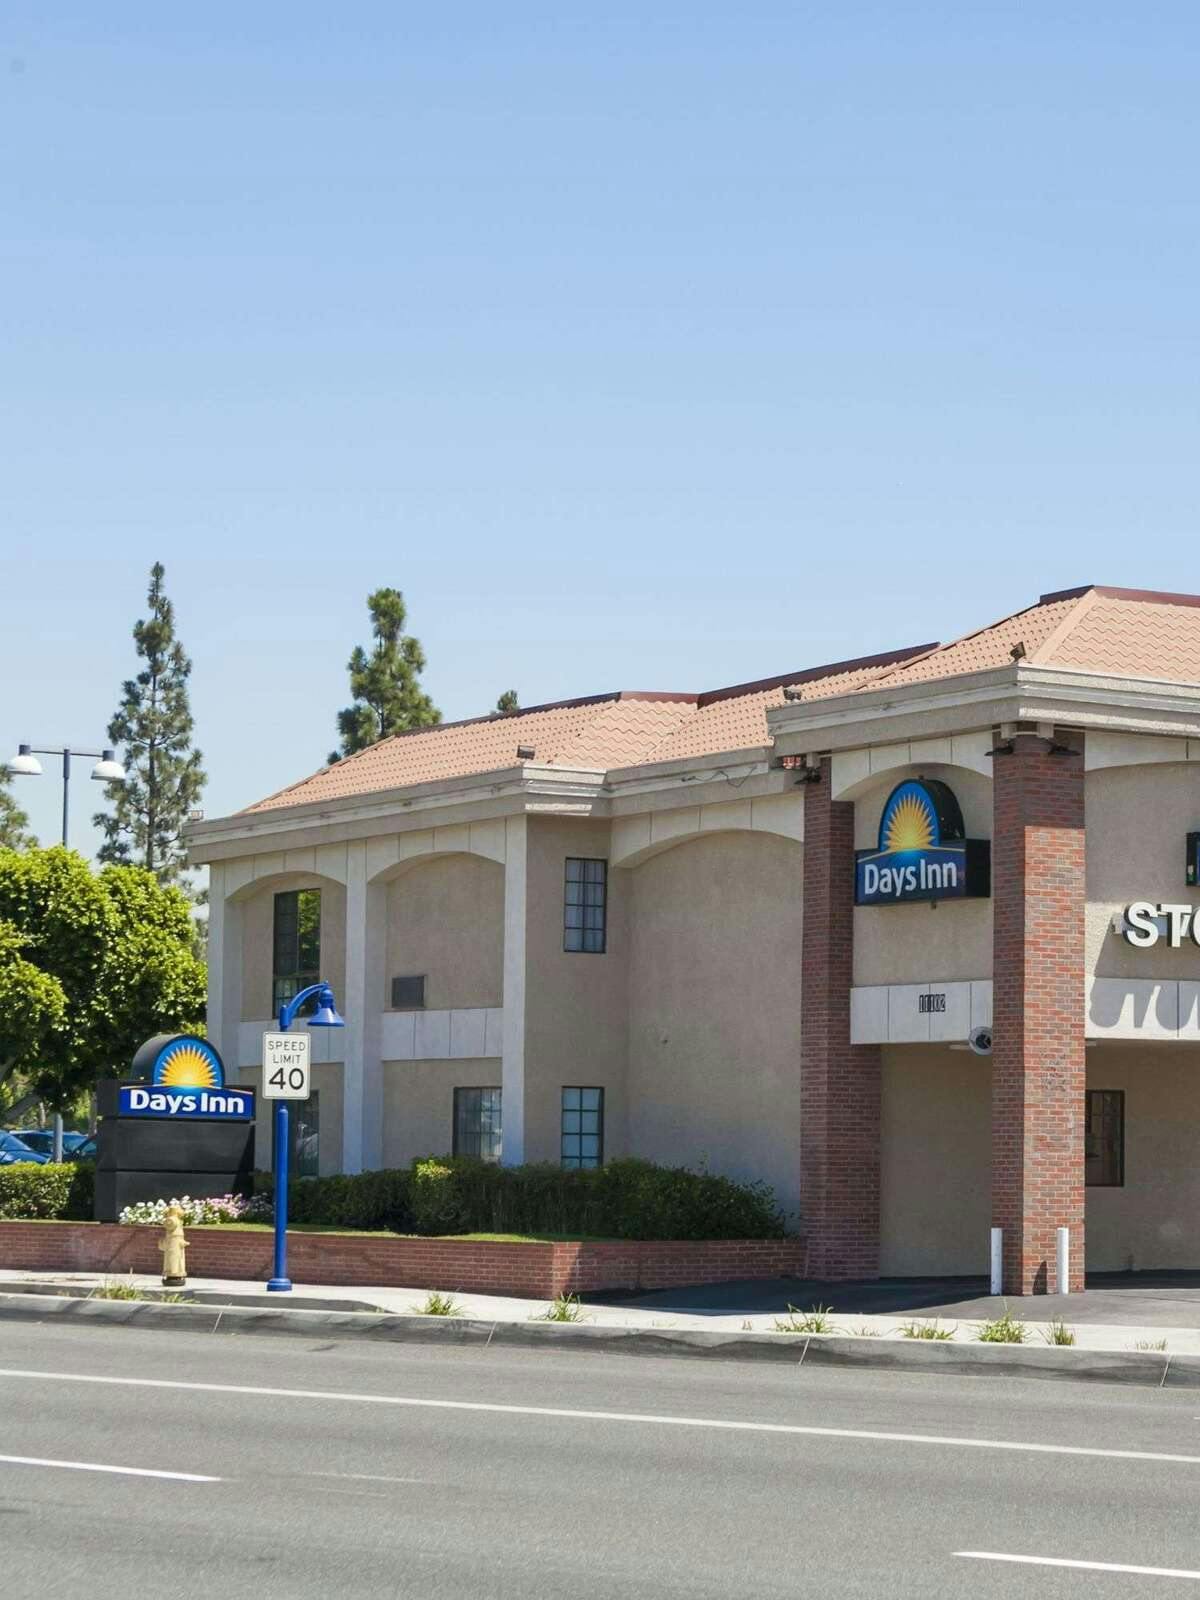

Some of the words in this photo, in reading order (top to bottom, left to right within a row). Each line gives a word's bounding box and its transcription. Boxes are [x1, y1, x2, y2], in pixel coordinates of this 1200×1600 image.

[864, 863, 917, 896] Days
[919, 858, 957, 889] Inn
[267, 1040, 306, 1052] SPEED
[272, 1054, 301, 1065] LIMIT
[268, 1067, 304, 1091] 40
[130, 1089, 197, 1114] Days
[201, 1092, 244, 1114] Inn
